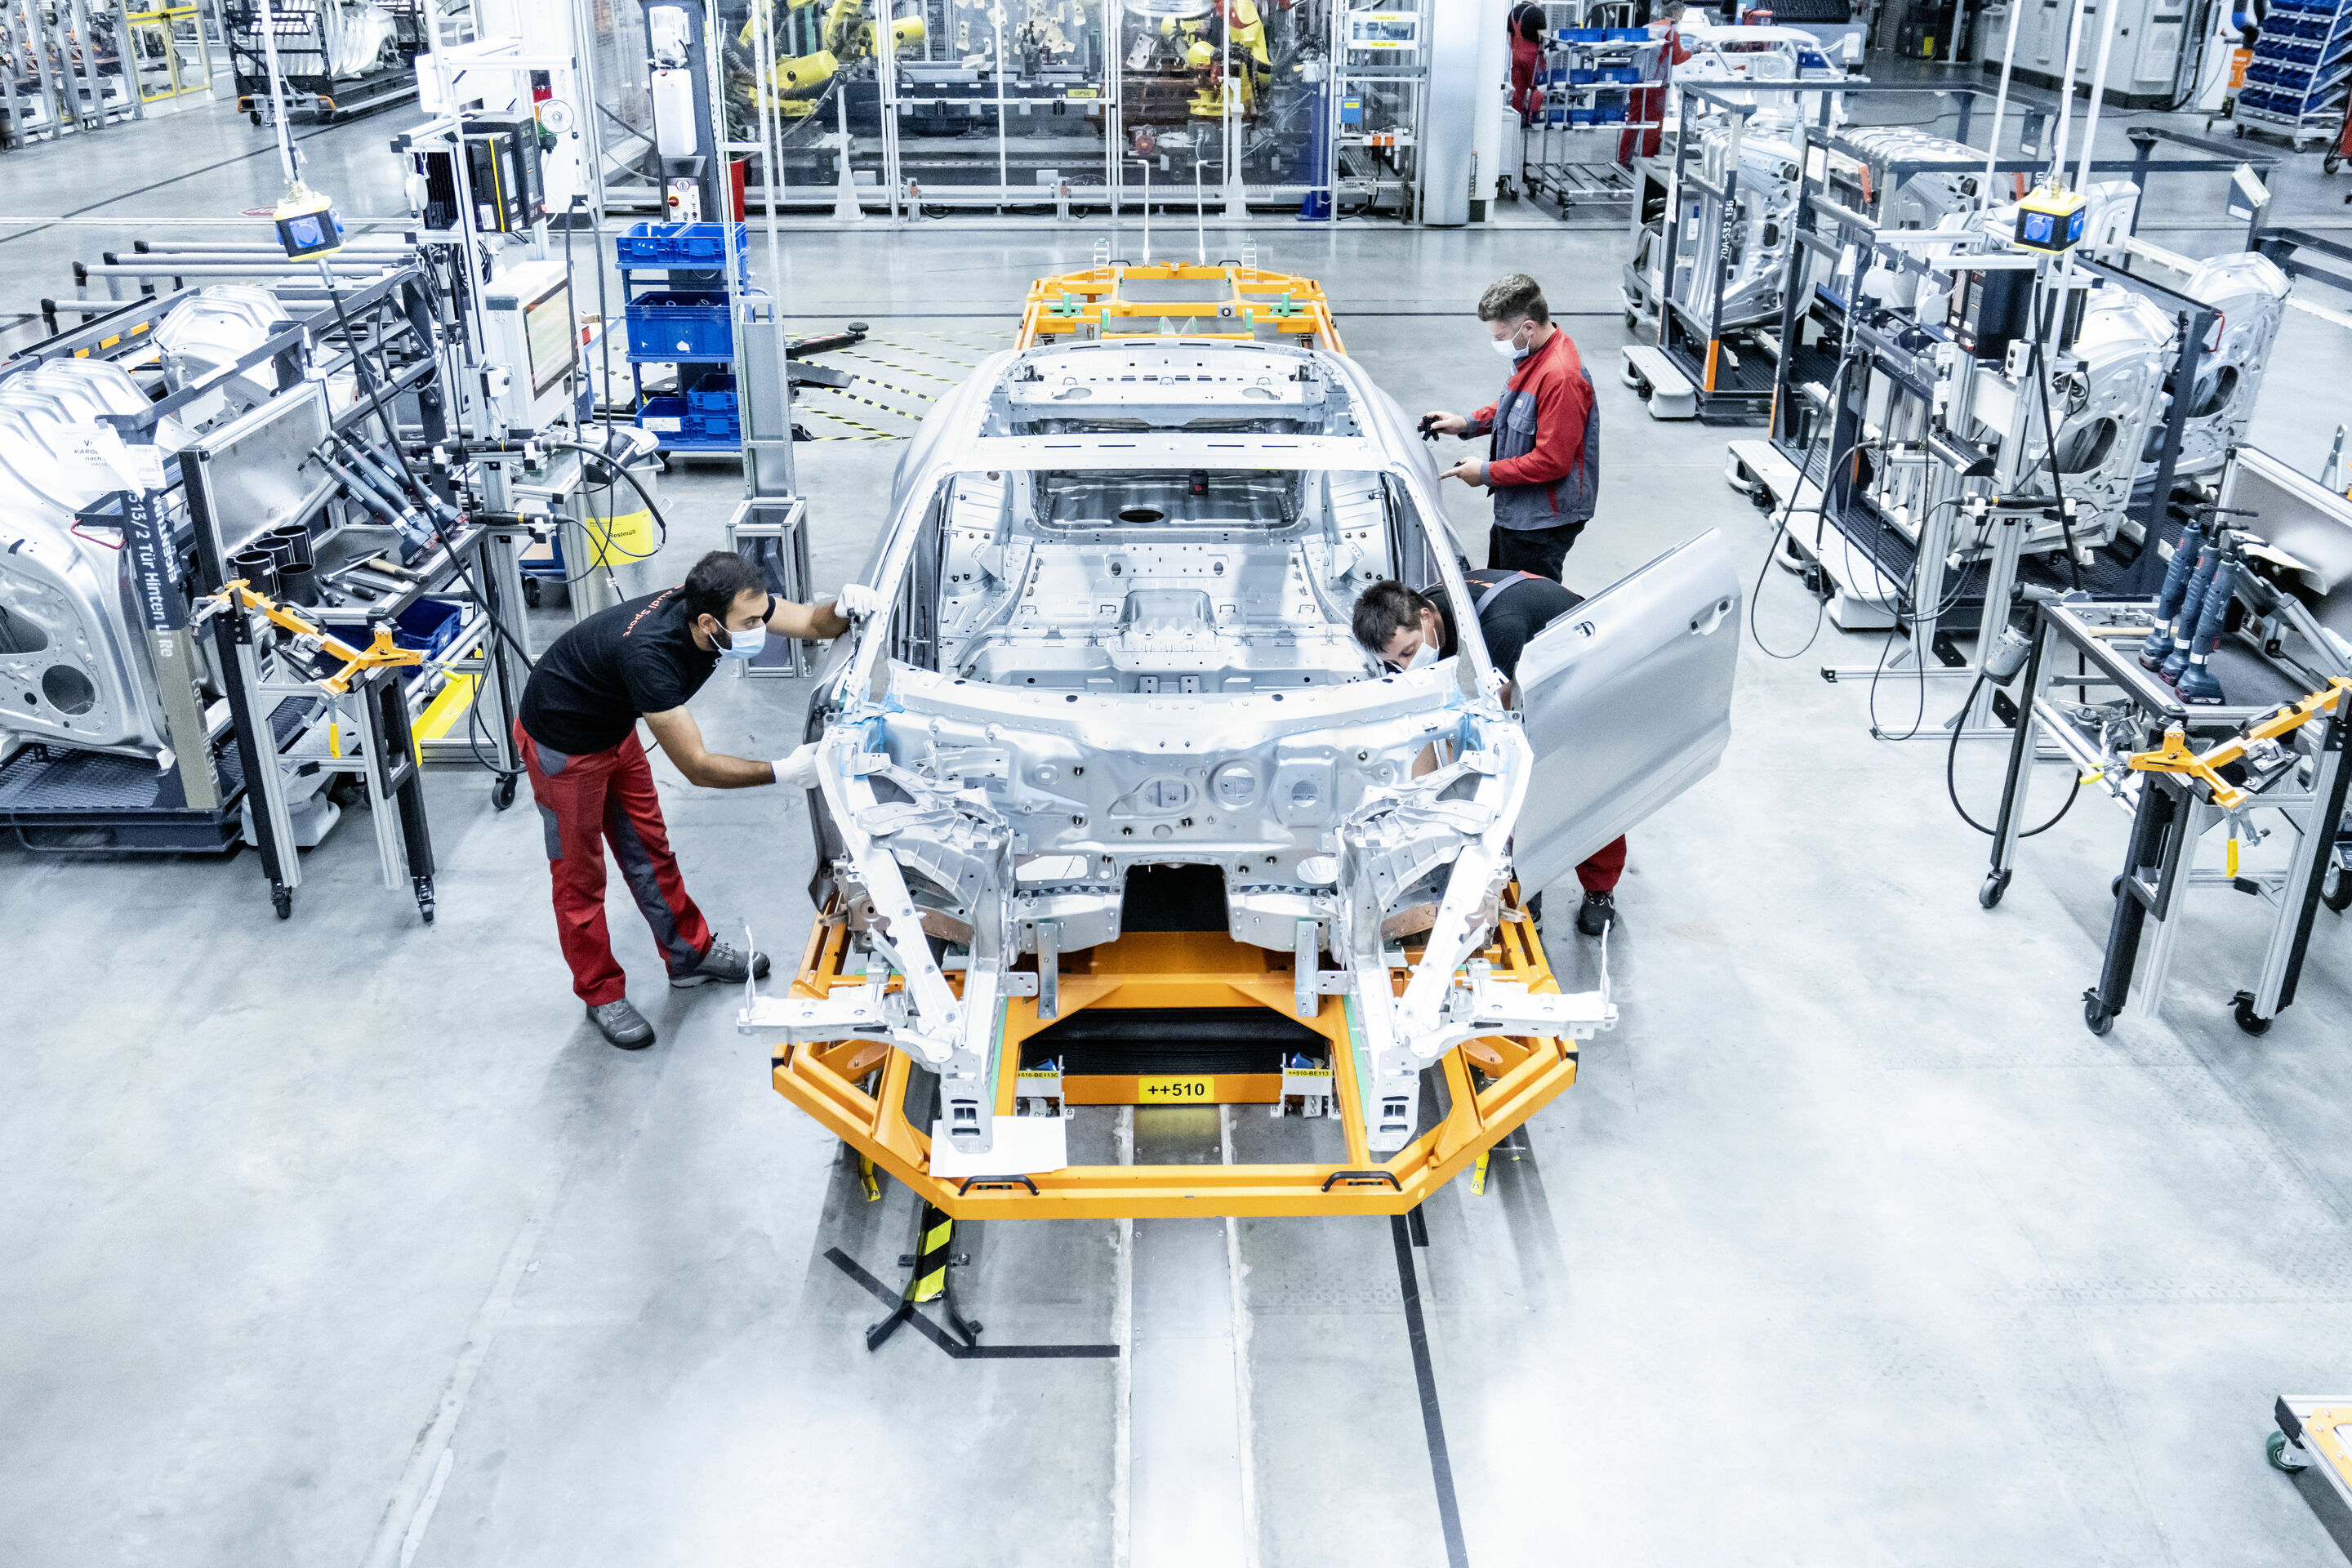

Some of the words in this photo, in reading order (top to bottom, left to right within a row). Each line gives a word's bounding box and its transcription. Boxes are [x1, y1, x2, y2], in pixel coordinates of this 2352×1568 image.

[1725, 199, 1734, 218] 136
[1720, 221, 1732, 261] 70A-532
[127, 490, 151, 539] 513/2
[153, 495, 177, 583] EIGENTUM
[138, 542, 155, 569] Tür
[144, 572, 166, 621] Hinten
[648, 590, 673, 609] Audi
[154, 624, 172, 635] Li
[622, 609, 651, 637] Sport
[158, 639, 173, 657] Re
[1147, 1083, 1205, 1096] ++510
